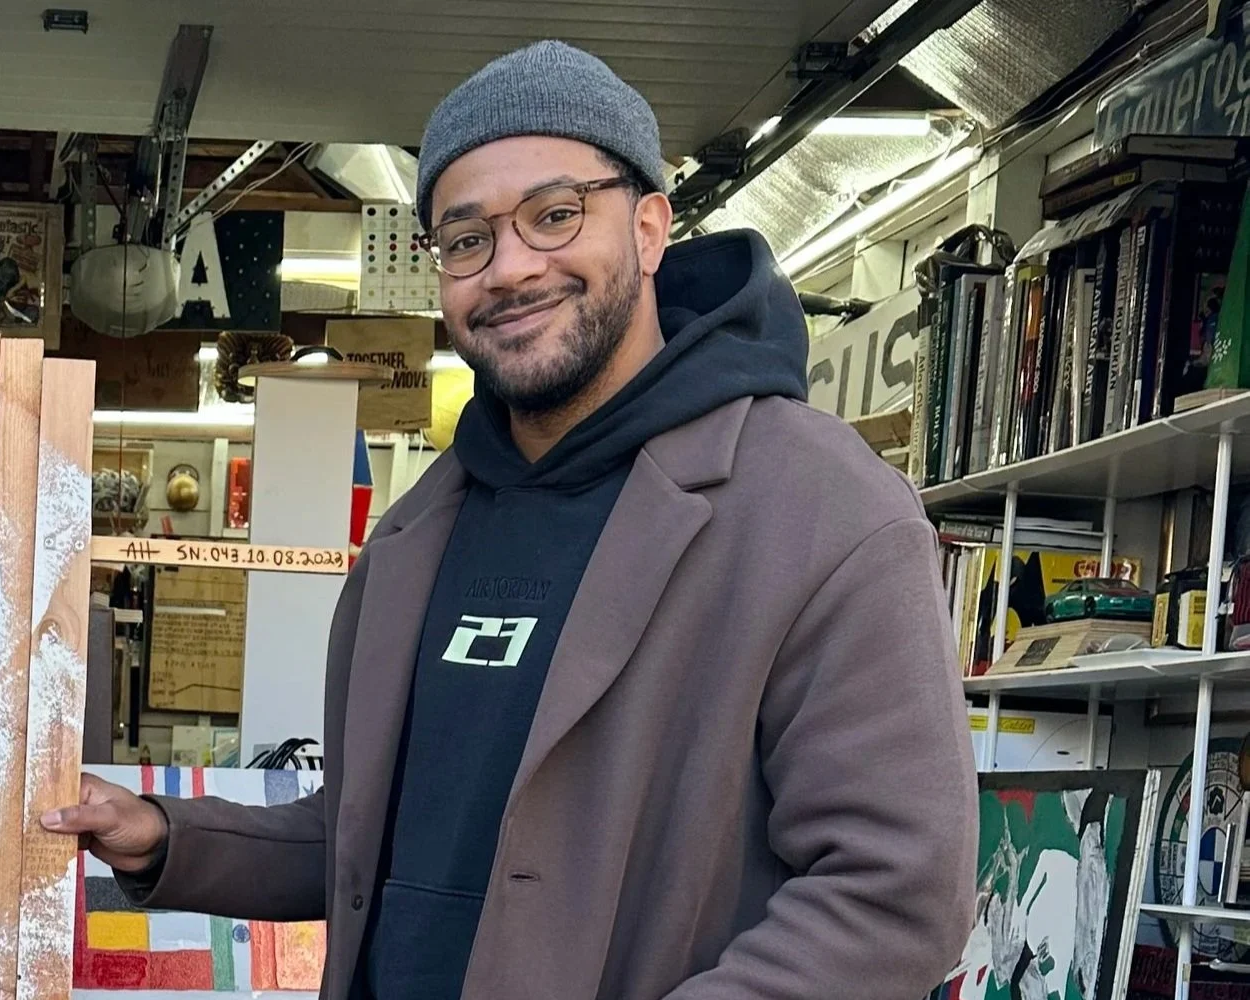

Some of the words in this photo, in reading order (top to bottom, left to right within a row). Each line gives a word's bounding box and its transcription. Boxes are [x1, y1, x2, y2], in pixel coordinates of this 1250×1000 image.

[1087, 287, 1102, 360] AFRICAN
[1109, 306, 1123, 391] MONDRIAN
[917, 355, 926, 391] Atlas
[1084, 363, 1095, 395] ART
[932, 404, 941, 451] ROLEX
